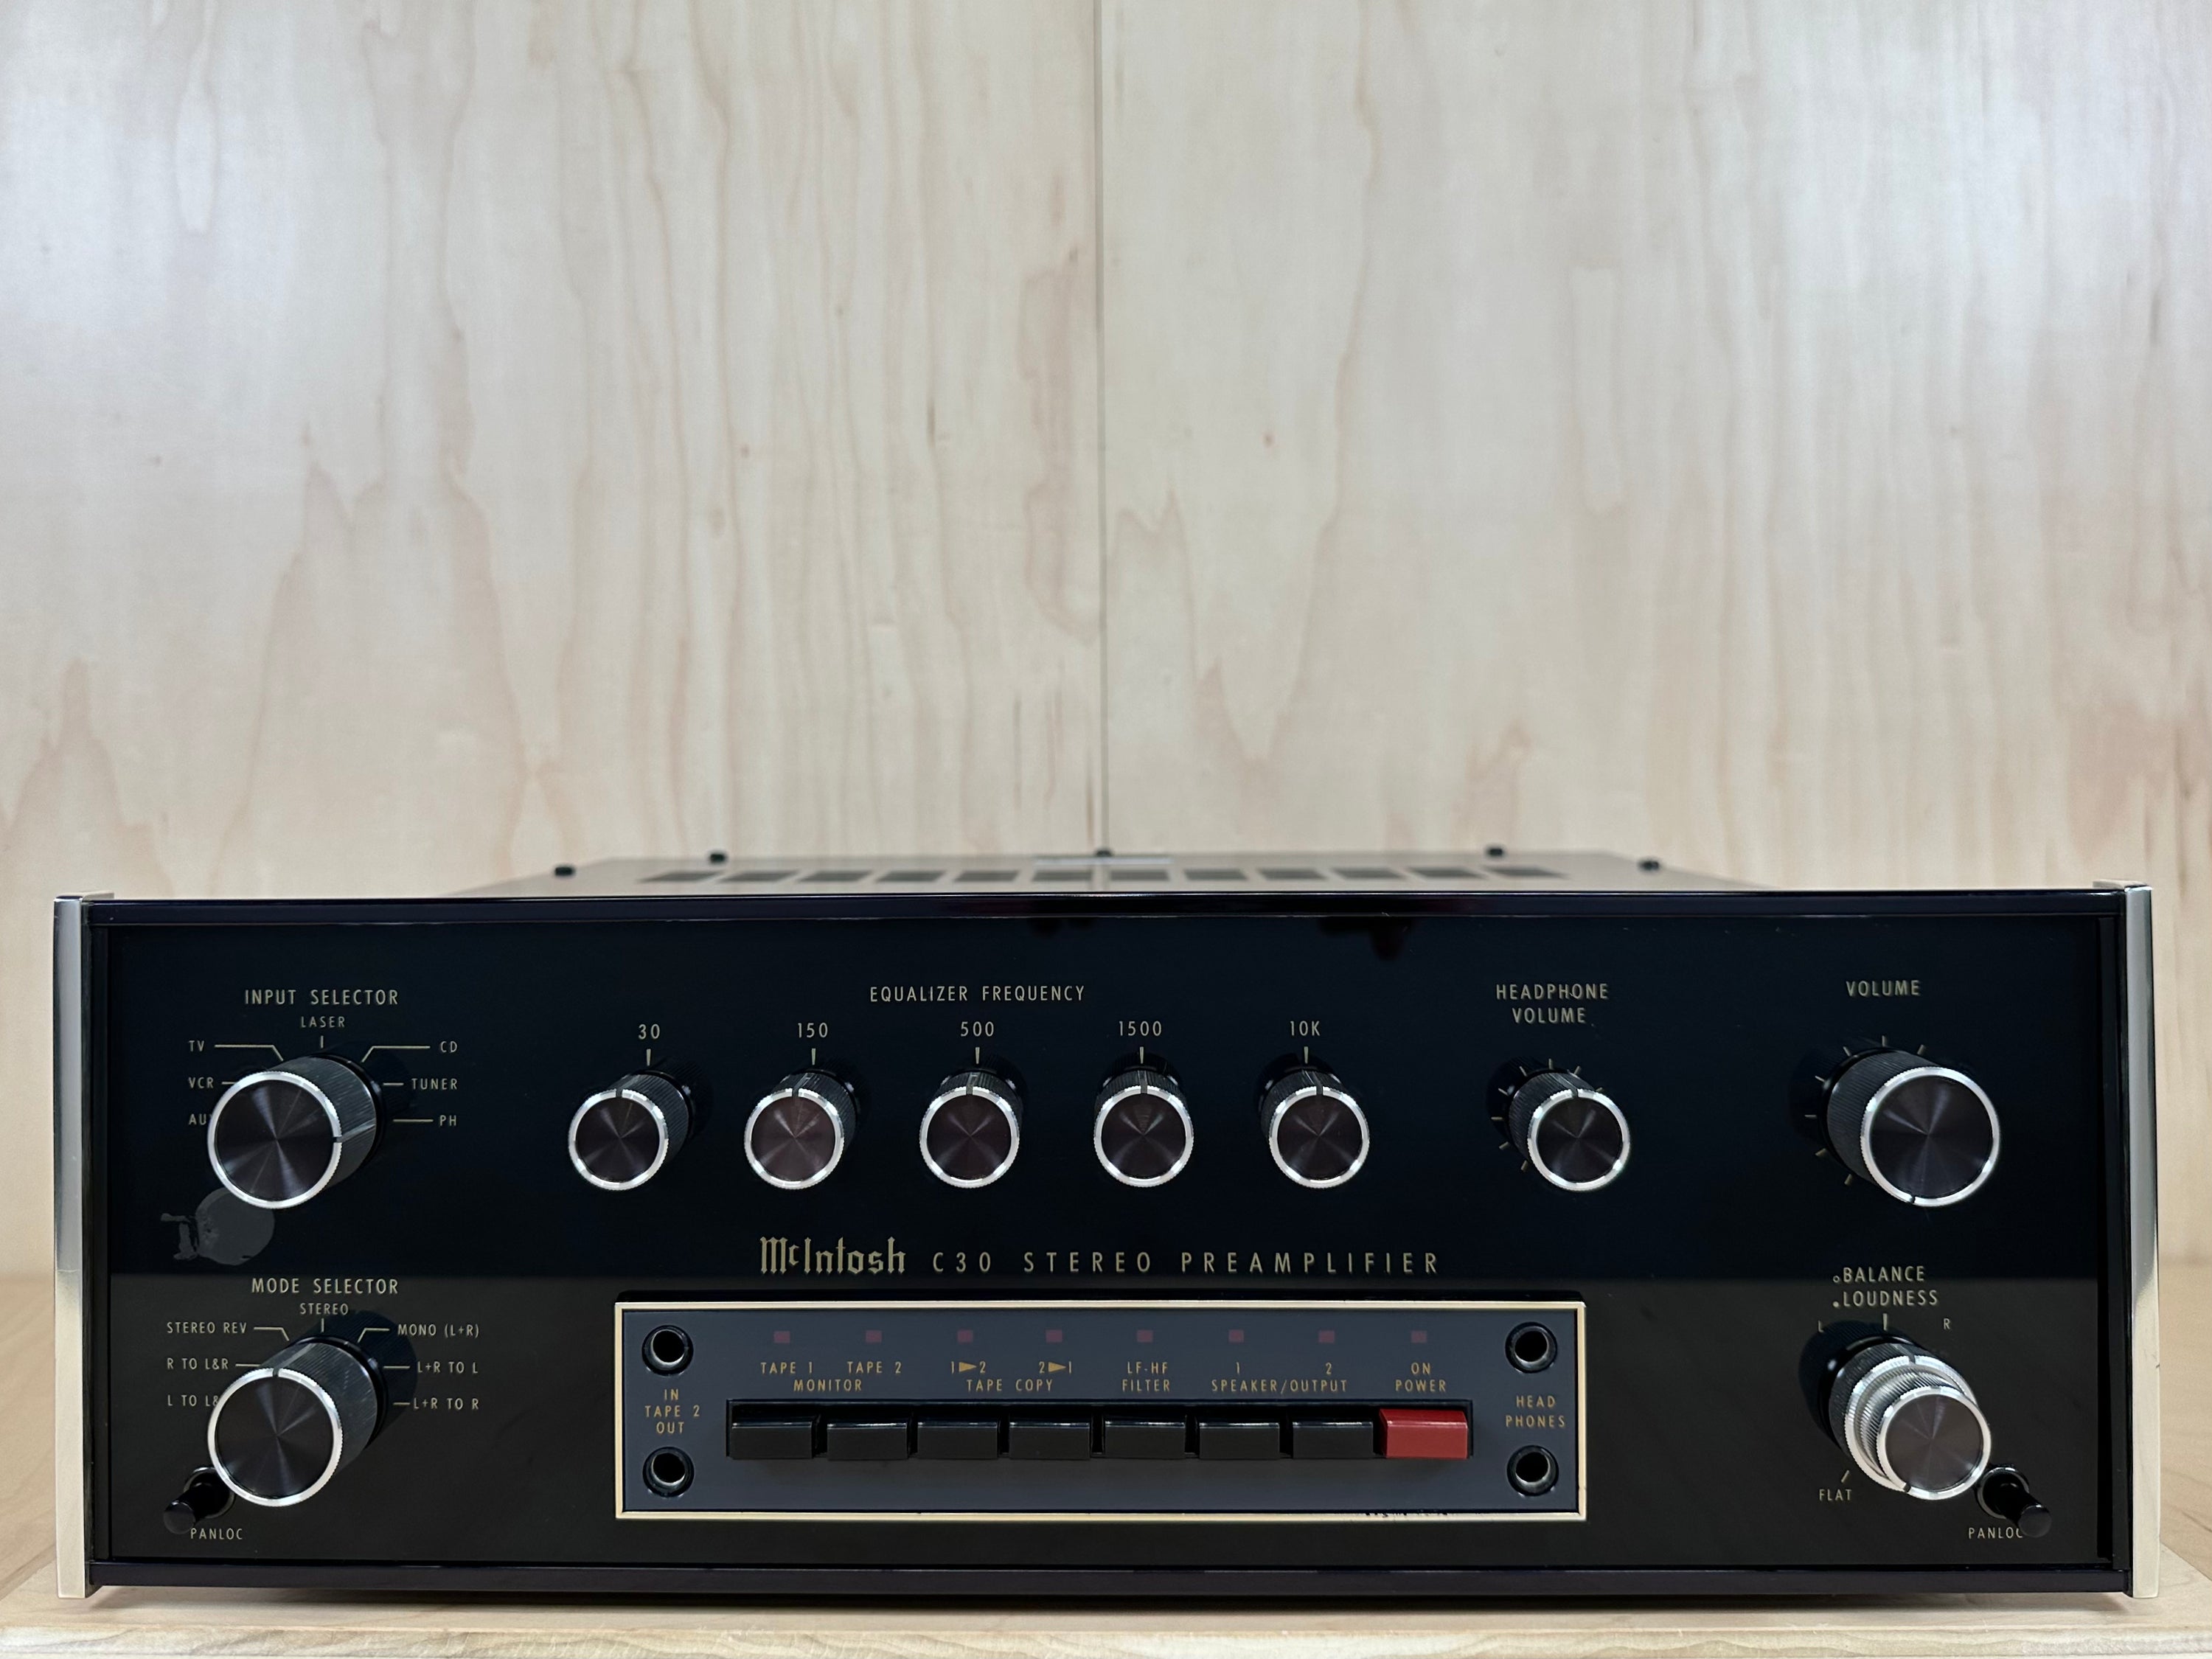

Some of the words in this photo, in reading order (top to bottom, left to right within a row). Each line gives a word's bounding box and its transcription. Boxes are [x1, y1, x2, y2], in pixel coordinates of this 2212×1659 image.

[870, 985, 967, 1002] EQUALIZER
[982, 985, 1085, 1001] FREQUENCY
[1496, 983, 1607, 1000] HEADPHONE
[1846, 979, 1919, 997] VOLUME
[245, 989, 296, 1005] INPUT
[310, 989, 398, 1005] SELECTOR
[301, 1015, 345, 1028] LASER
[1512, 1007, 1585, 1024] VOLUME
[639, 1023, 661, 1040] 30
[798, 1022, 828, 1038] 150
[960, 1021, 994, 1037] 500
[1119, 1020, 1162, 1037] 1500
[1290, 1020, 1320, 1037] 10K
[188, 1040, 205, 1052] TV
[440, 1040, 458, 1053] CD
[188, 1077, 214, 1089] VCR
[411, 1078, 458, 1091] TUNER
[188, 1113, 212, 1125] AU
[439, 1114, 456, 1127] PH
[759, 1236, 906, 1275] McIntosh
[933, 1251, 991, 1273] C30
[1023, 1251, 1150, 1273] STEREO
[1181, 1252, 1436, 1273] PREAMPLIFIER
[1843, 1265, 1924, 1284] BALANCE
[251, 1277, 299, 1293] MODE
[313, 1278, 398, 1295] SELECTOR
[1843, 1290, 1938, 1307] LOUDNESS
[299, 1302, 349, 1315] STEREO
[167, 1321, 215, 1334] STEREO
[223, 1321, 247, 1334] REV
[1818, 1320, 1824, 1332] L
[1943, 1318, 1950, 1330] R
[397, 1324, 437, 1337] MONO
[444, 1324, 479, 1338] (L+R)
[167, 1357, 174, 1369] R
[182, 1357, 198, 1370] TO
[205, 1357, 229, 1370] L&R
[417, 1360, 441, 1373] L+R
[448, 1361, 465, 1374] TO
[472, 1362, 479, 1374] L
[760, 1361, 796, 1374] TAPE
[809, 1361, 813, 1374] 1
[847, 1361, 882, 1374] TAPE
[895, 1361, 902, 1374] 2
[1127, 1361, 1167, 1374] LF-HF
[1236, 1362, 1240, 1374] 1
[1325, 1362, 1332, 1375] 2
[1411, 1362, 1430, 1375] ON
[793, 1379, 862, 1392] MONITOR
[967, 1379, 1002, 1391] TAPE
[1015, 1378, 1052, 1391] COPY
[1122, 1379, 1170, 1392] FILTER
[1211, 1379, 1346, 1394] SPEAKER/OUTPUT
[1395, 1379, 1446, 1392] POWER
[167, 1394, 173, 1407] L
[181, 1394, 197, 1407] TO
[205, 1394, 219, 1407] L&
[664, 1388, 679, 1401] IN
[414, 1397, 438, 1410] L+R
[447, 1397, 464, 1411] TO
[472, 1398, 479, 1410] R
[1516, 1395, 1556, 1408] HEAD
[644, 1405, 681, 1418] TAPE
[693, 1405, 700, 1417] 2
[656, 1421, 684, 1434] OUT
[1506, 1415, 1565, 1428] PHONES
[1819, 1489, 1851, 1501] FLAT
[190, 1527, 243, 1540] PANLOC
